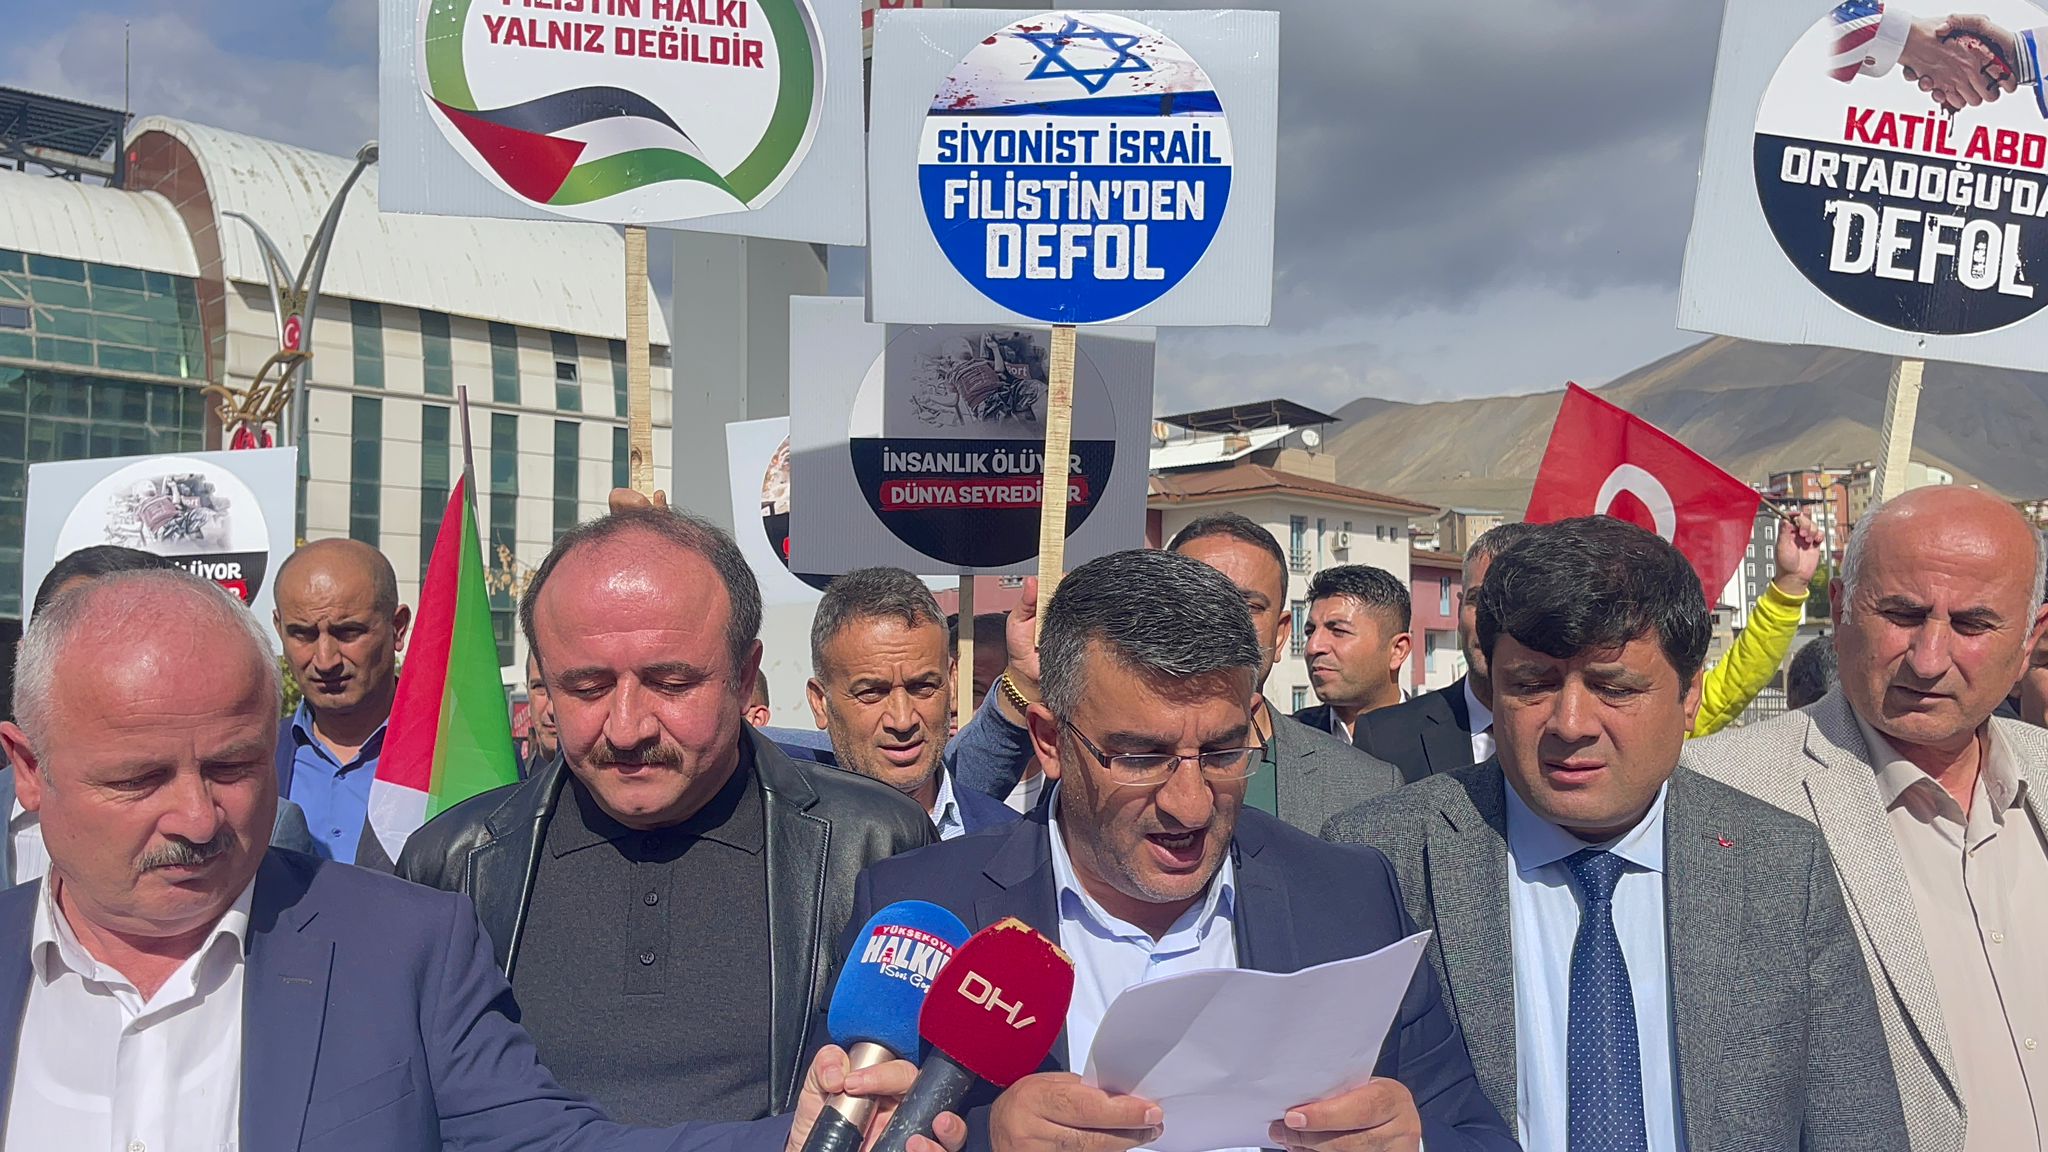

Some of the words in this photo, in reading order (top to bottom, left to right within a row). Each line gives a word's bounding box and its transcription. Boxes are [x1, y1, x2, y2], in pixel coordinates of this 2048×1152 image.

[652, 0, 747, 28] HALKI
[483, 14, 605, 54] YALNIZ
[615, 24, 765, 69] DEĞİLDİR
[937, 121, 1099, 164] SİYONİST
[1109, 121, 1222, 164] İSRAİL
[1844, 105, 1957, 156] KATİL
[1964, 125, 2047, 169] ABD
[943, 170, 1205, 221] FİLİSTİN'DEN
[985, 222, 1166, 281] DEFOL
[1825, 199, 2034, 299] DEFOL
[883, 446, 989, 474] İNSANLIK
[991, 448, 1083, 475] ÖLÜYR
[890, 482, 958, 504] DÜNYA
[959, 480, 1082, 504] SEYREDİR
[175, 561, 242, 580] ÜYOR
[882, 925, 953, 957] YÜKSEKOVA
